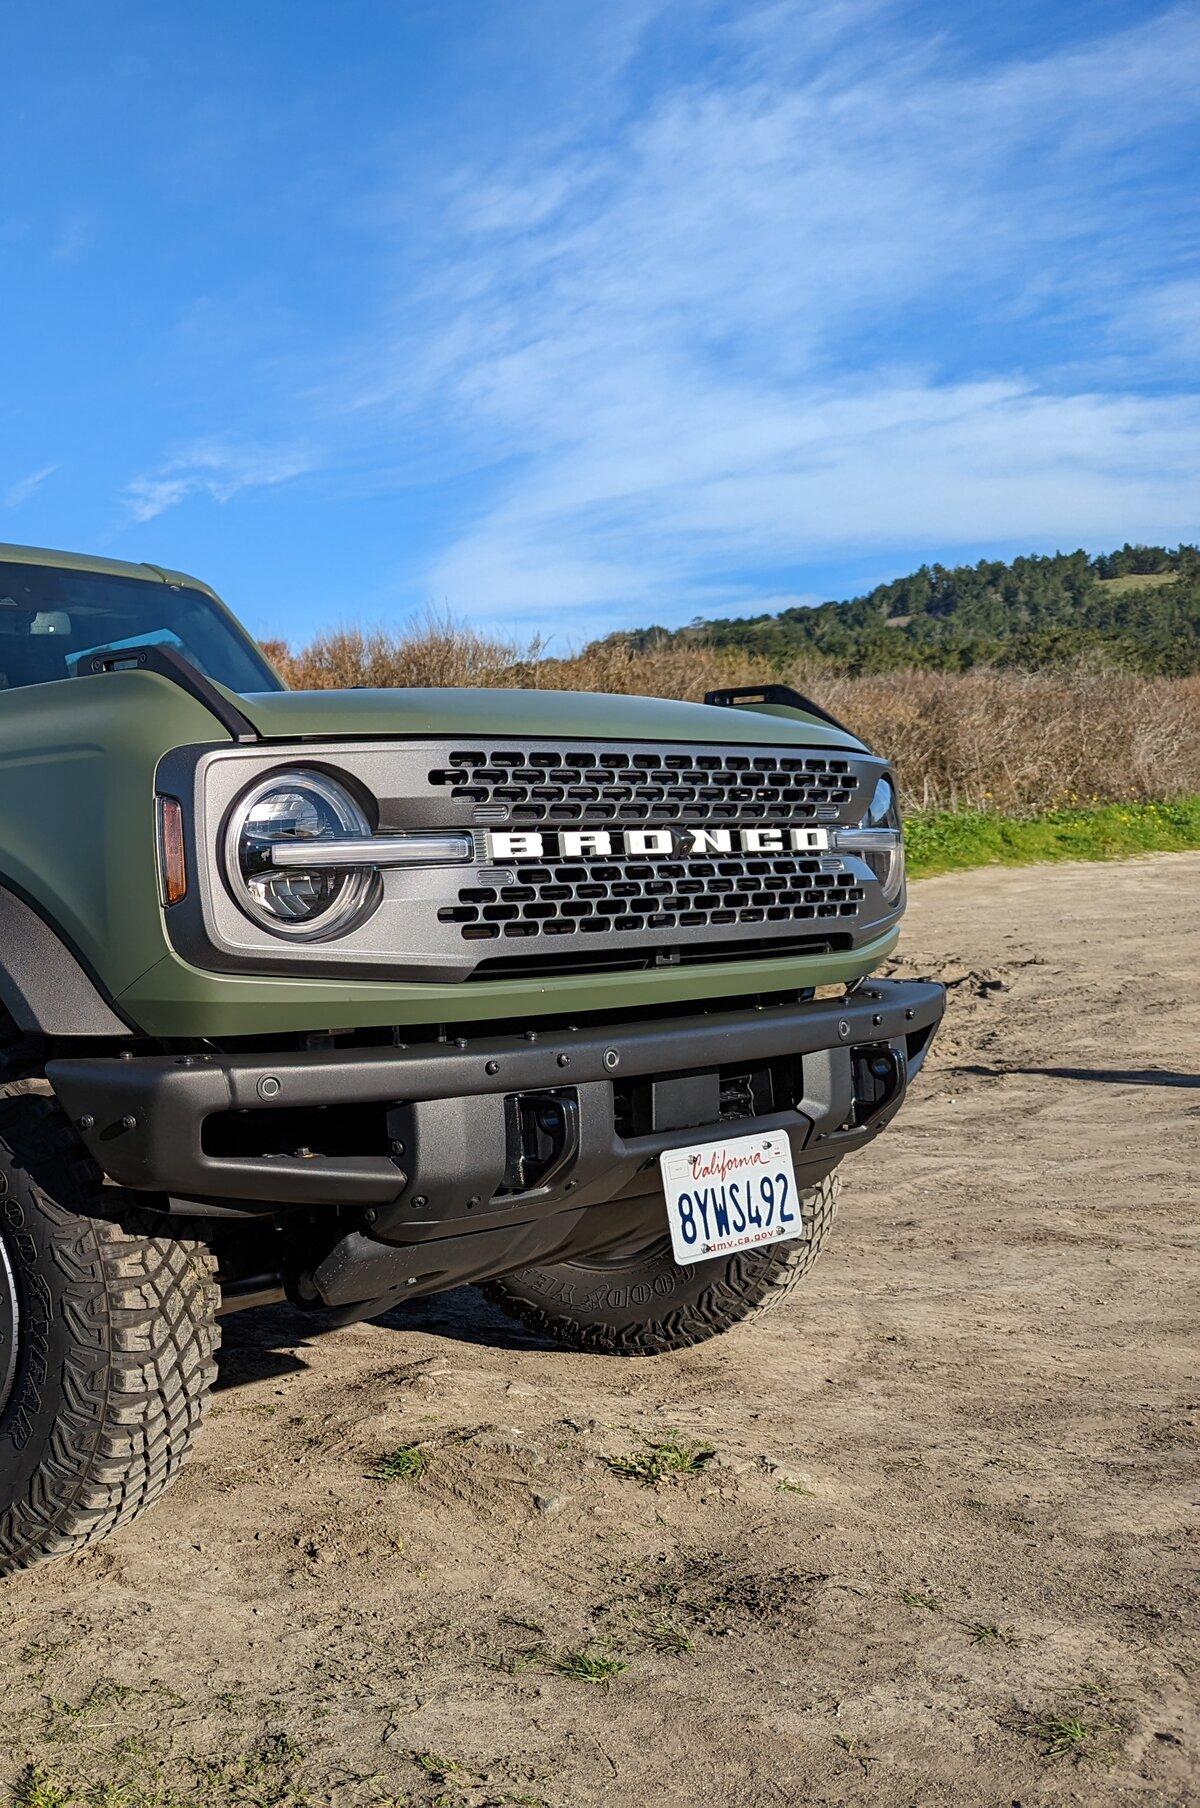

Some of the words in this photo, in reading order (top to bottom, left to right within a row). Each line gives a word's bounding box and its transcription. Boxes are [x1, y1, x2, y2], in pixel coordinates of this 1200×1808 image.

[488, 829, 829, 859] BRONCO
[691, 1149, 771, 1182] California
[677, 1172, 794, 1245] 8YWS492
[709, 1229, 775, 1252] dmv.ca.gov
